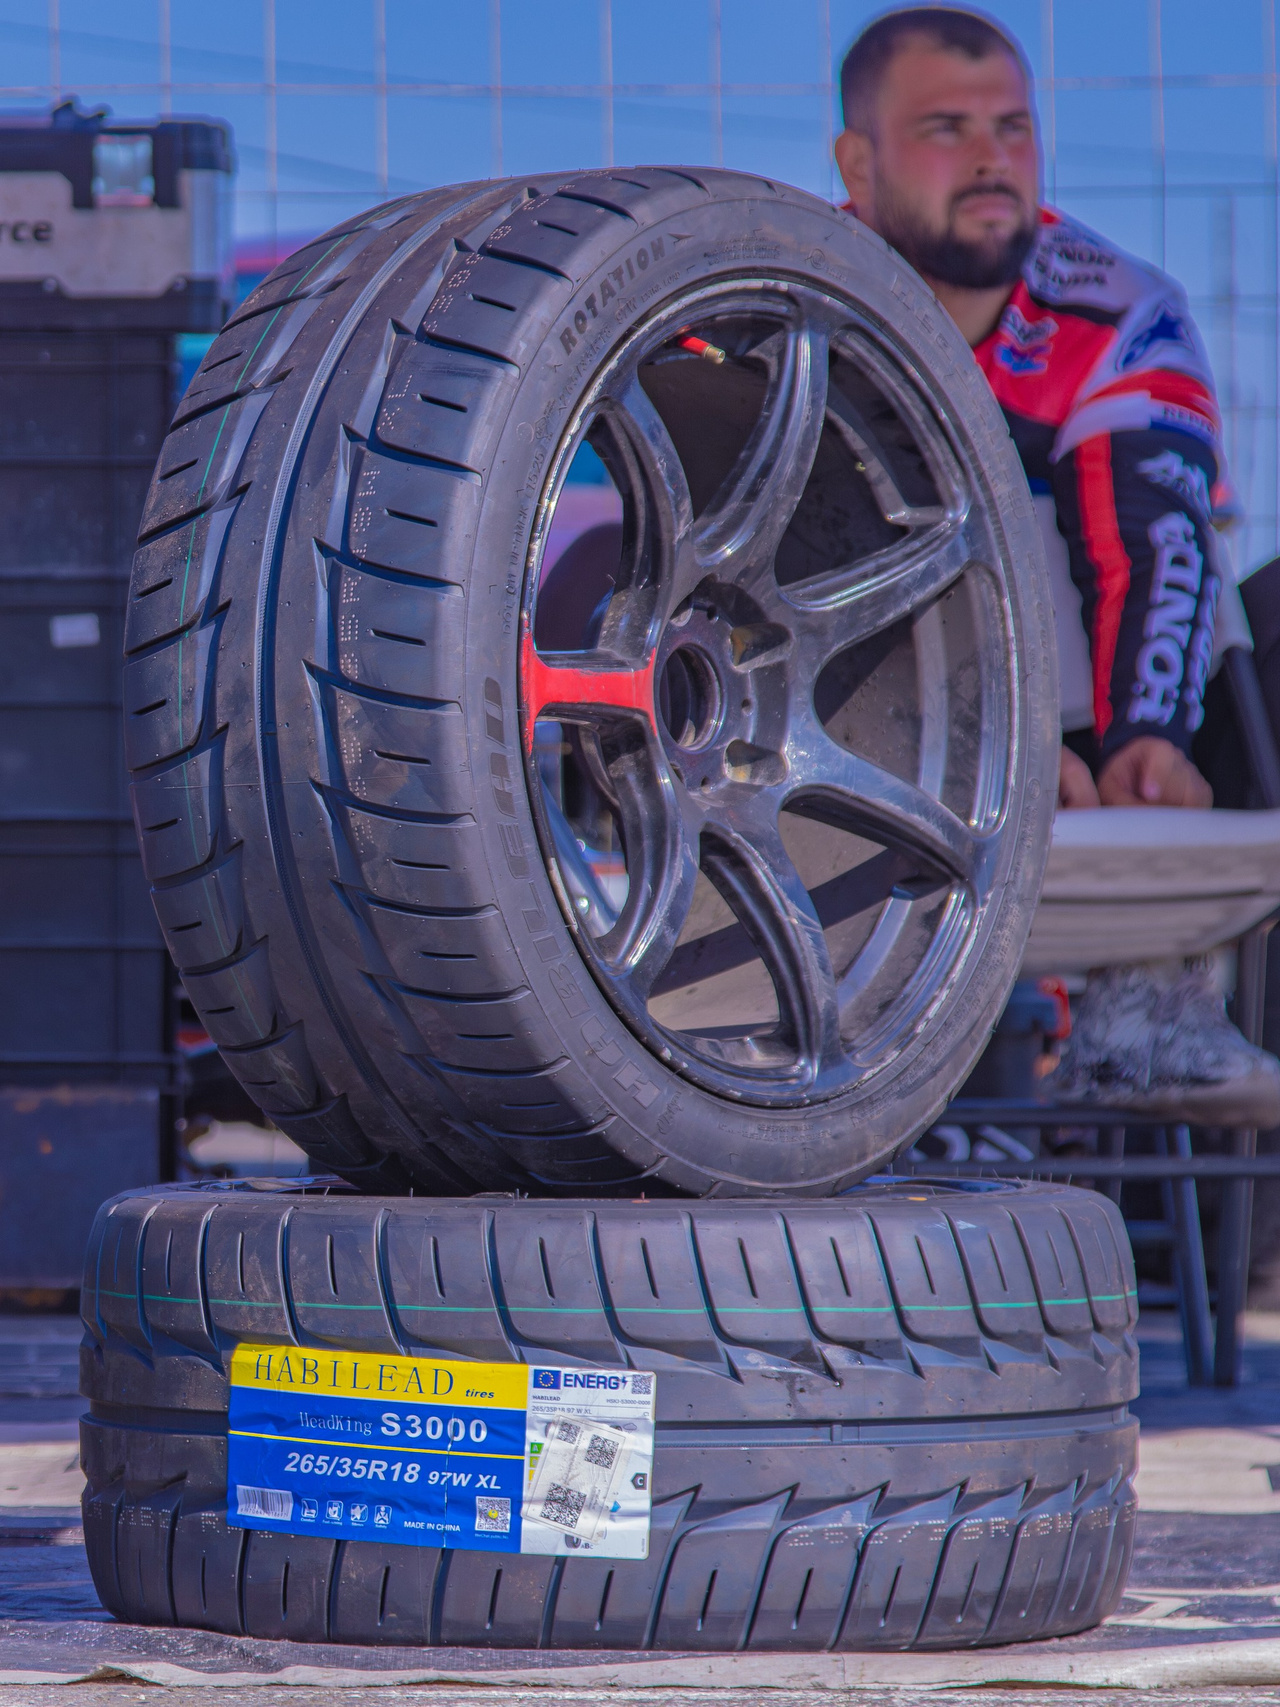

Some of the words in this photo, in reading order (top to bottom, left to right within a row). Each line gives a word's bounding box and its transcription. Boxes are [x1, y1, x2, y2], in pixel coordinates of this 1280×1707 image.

[558, 234, 666, 355] ROTATION
[1126, 511, 1204, 726] HONDA
[484, 677, 661, 1110] HABILEAD
[253, 1353, 455, 1396] HABILEAD
[464, 1388, 495, 1399] tires
[563, 1373, 619, 1390] ENERG
[299, 1411, 372, 1436] HeadKing
[381, 1412, 488, 1443] S3000
[284, 1452, 421, 1484] 265/35R18
[427, 1469, 472, 1488] 97W
[475, 1473, 501, 1490] XL
[404, 1521, 425, 1529] MADE
[436, 1524, 460, 1532] CHINA
